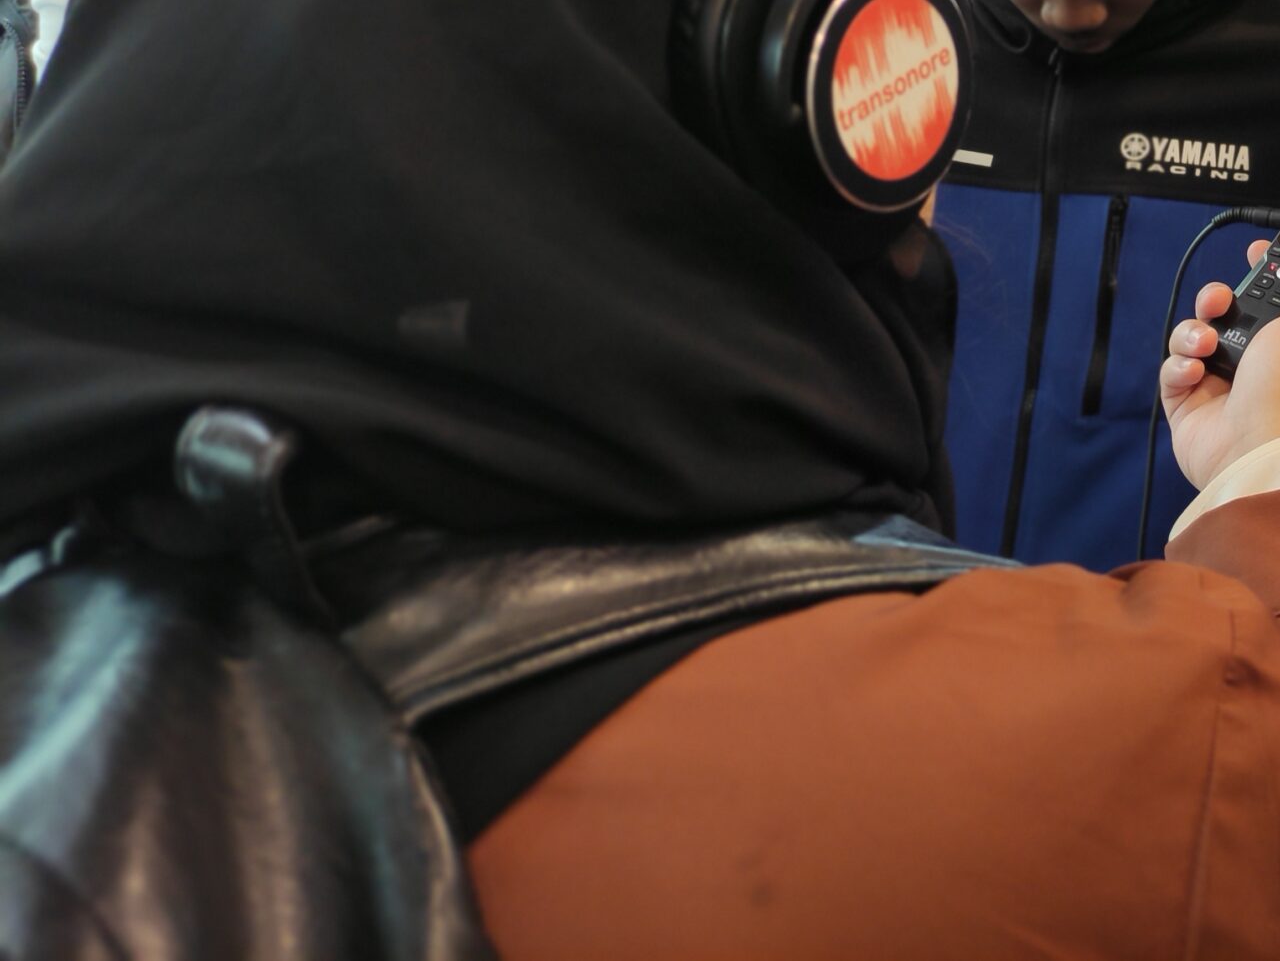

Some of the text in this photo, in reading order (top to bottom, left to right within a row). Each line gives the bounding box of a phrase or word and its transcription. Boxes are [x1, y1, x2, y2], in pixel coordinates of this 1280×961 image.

[837, 46, 951, 132] transonore
[1152, 136, 1249, 171] YAMAHA
[1126, 160, 1249, 181] RACING
[1223, 329, 1247, 345] H1n
